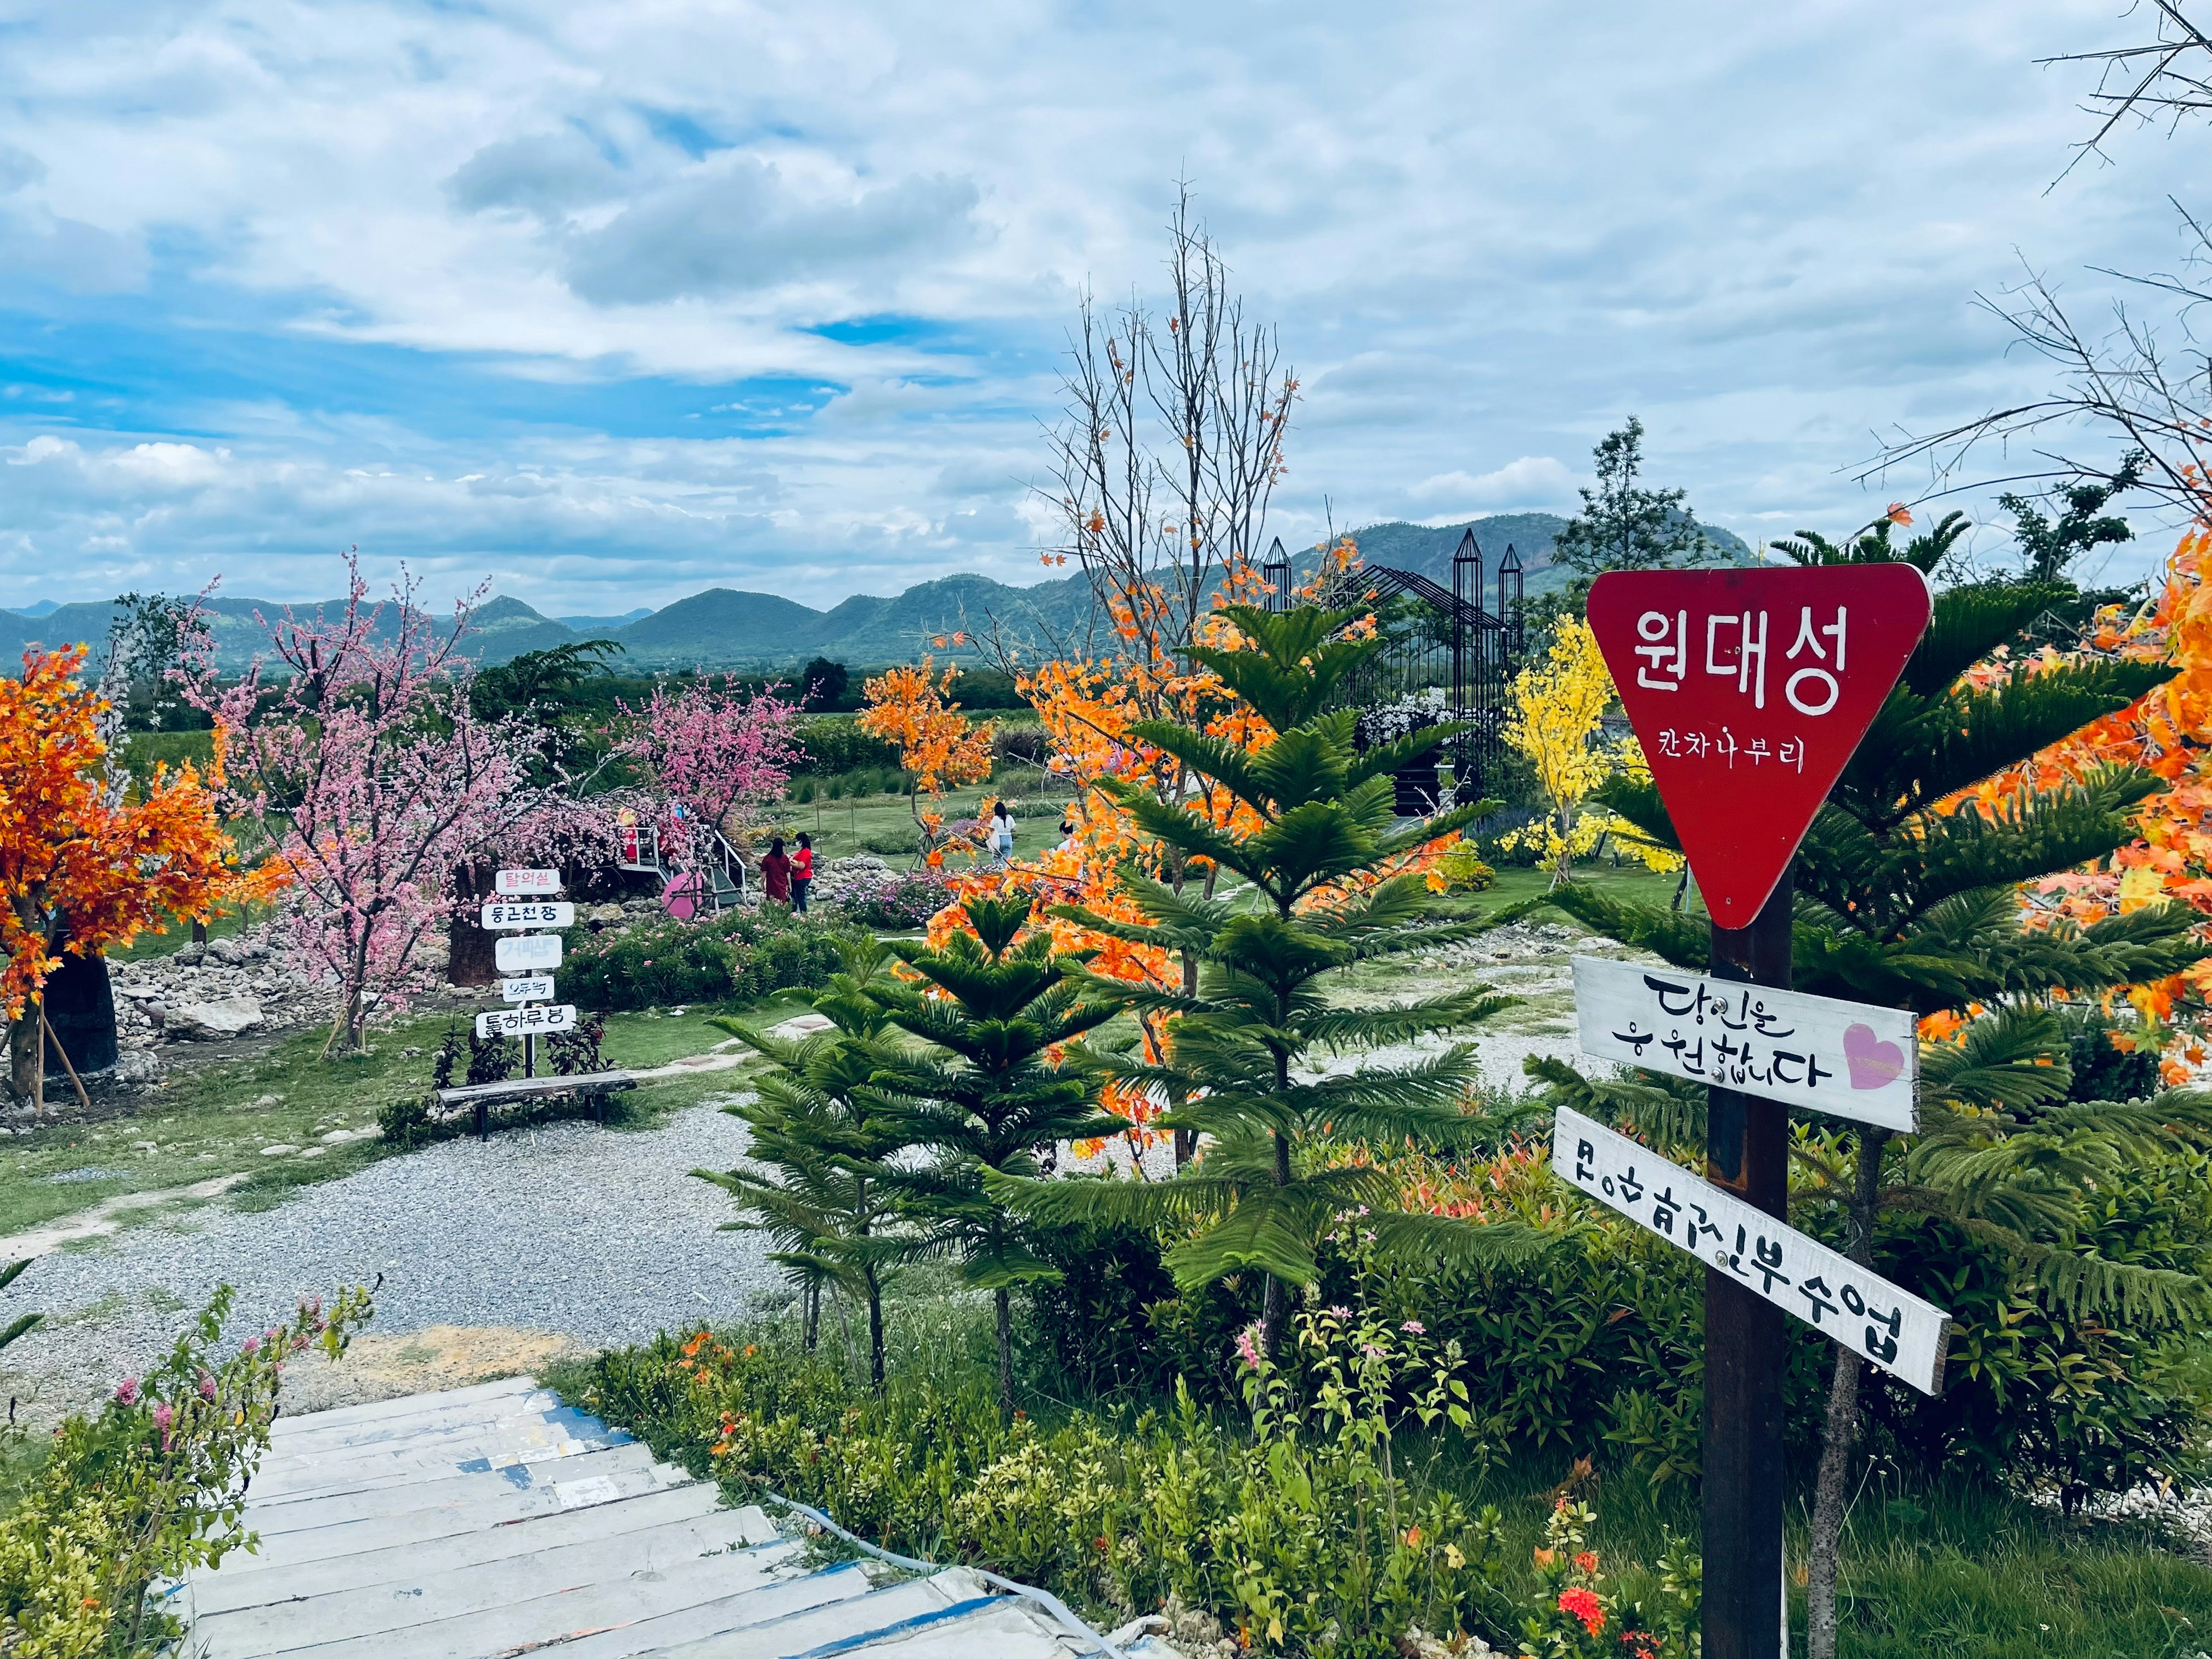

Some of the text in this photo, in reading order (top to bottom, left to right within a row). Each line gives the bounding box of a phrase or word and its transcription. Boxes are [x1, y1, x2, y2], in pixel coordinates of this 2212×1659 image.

[1635, 606, 1847, 716] 원대성
[1658, 726, 1804, 774] 칸차나부리
[492, 906, 557, 923] 둥근천장
[1611, 1021, 1832, 1087] 응원합니다
